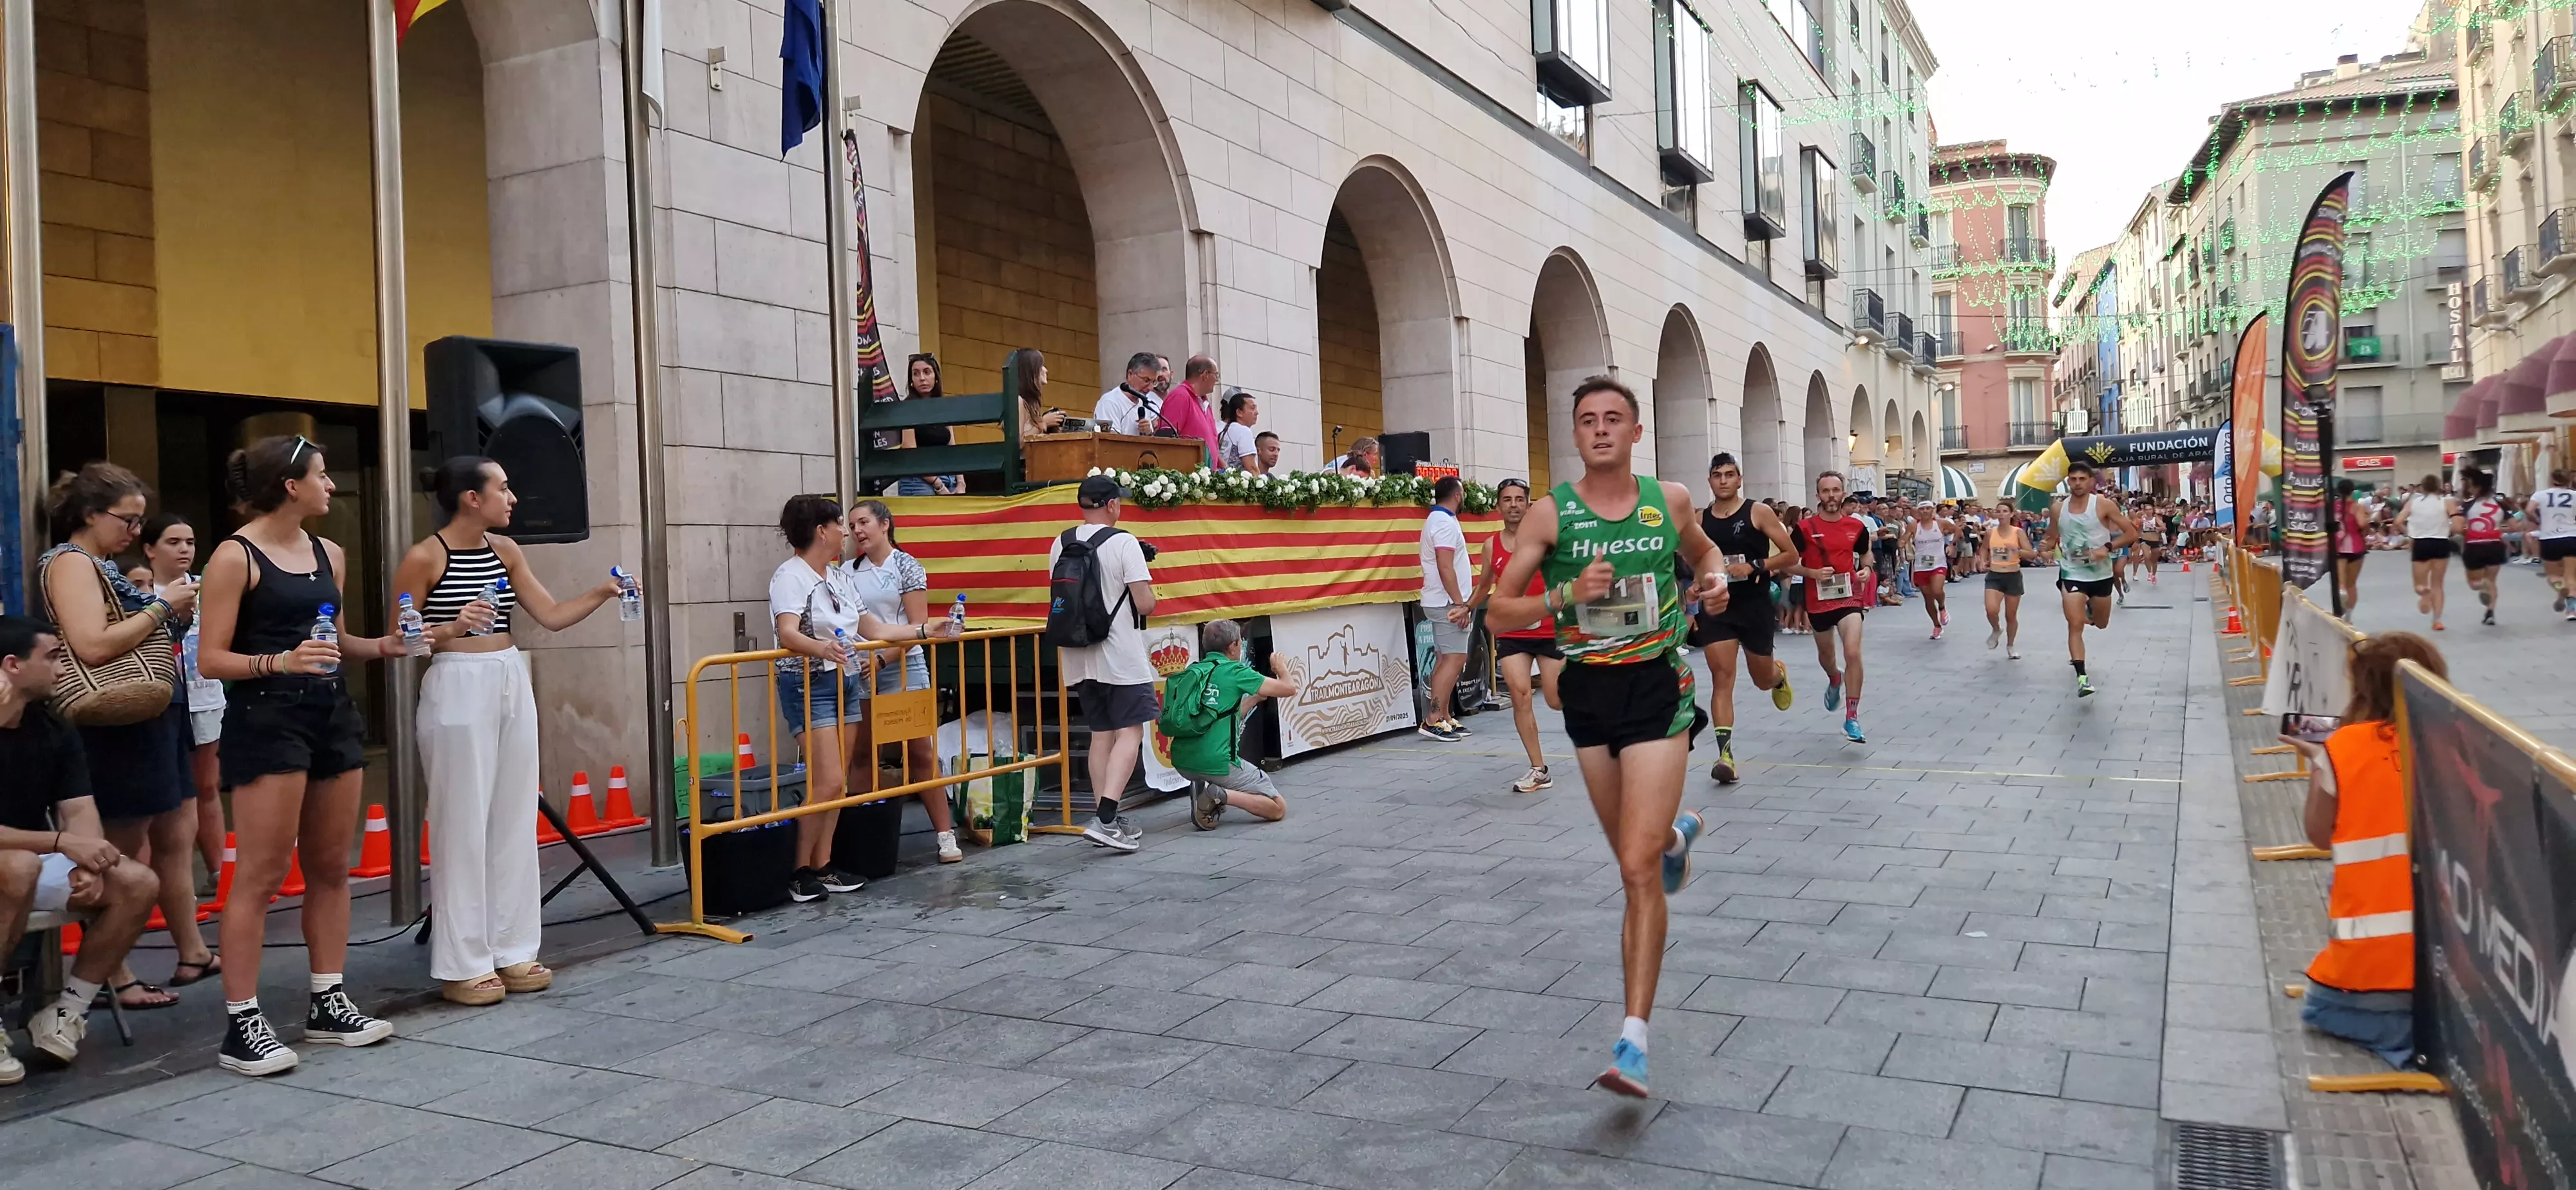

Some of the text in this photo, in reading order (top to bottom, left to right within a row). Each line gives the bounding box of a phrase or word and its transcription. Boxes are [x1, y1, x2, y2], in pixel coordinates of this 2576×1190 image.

[2448, 281, 2463, 363] HOSTAL
[2130, 436, 2208, 453] FUNDACIÓN
[2546, 492, 2572, 508] 12
[1572, 536, 1663, 558] Huesca
